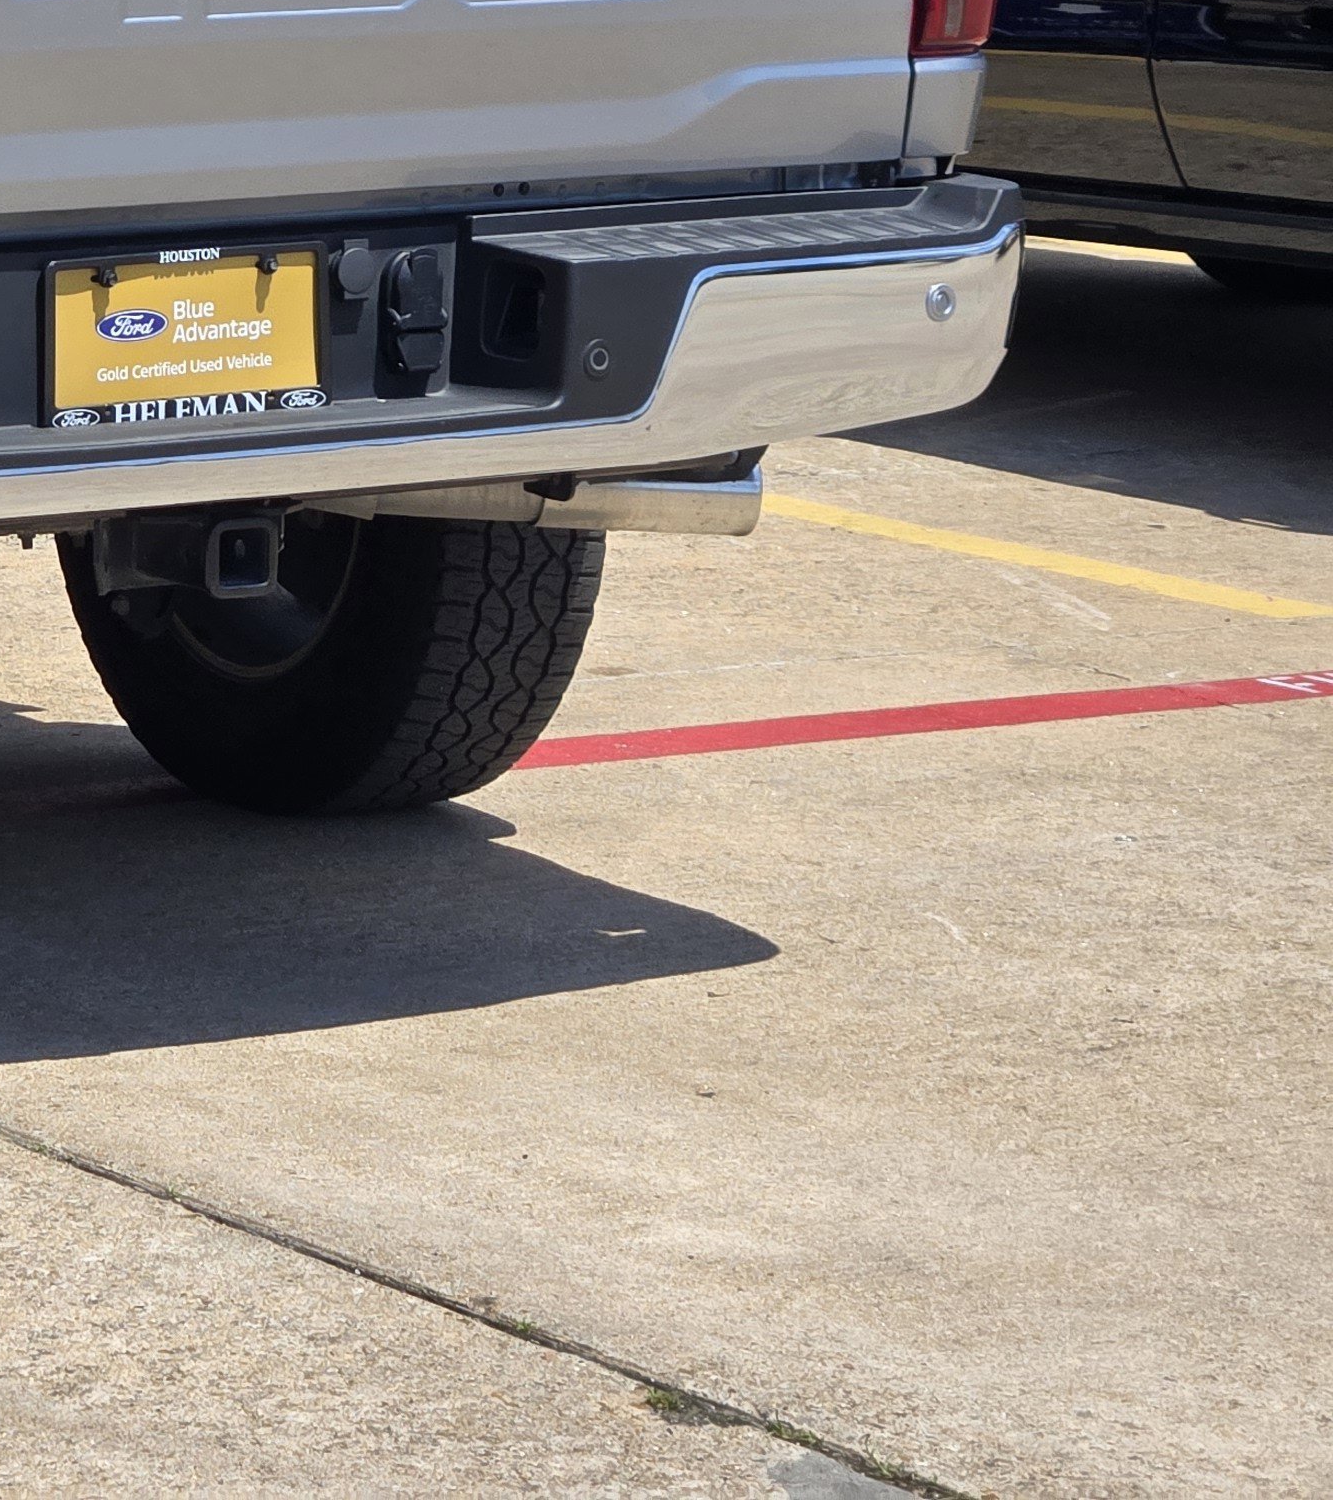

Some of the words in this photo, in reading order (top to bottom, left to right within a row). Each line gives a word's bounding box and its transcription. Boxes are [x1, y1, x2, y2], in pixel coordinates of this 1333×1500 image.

[159, 247, 221, 264] HOUSTON
[172, 299, 215, 320] Blue
[110, 314, 154, 337] Ford
[171, 318, 272, 344] Advantage
[96, 366, 129, 382] Gold
[131, 362, 187, 380] Certified
[189, 357, 224, 374] Used
[226, 353, 273, 370] Vehicle
[287, 392, 319, 409] Ford
